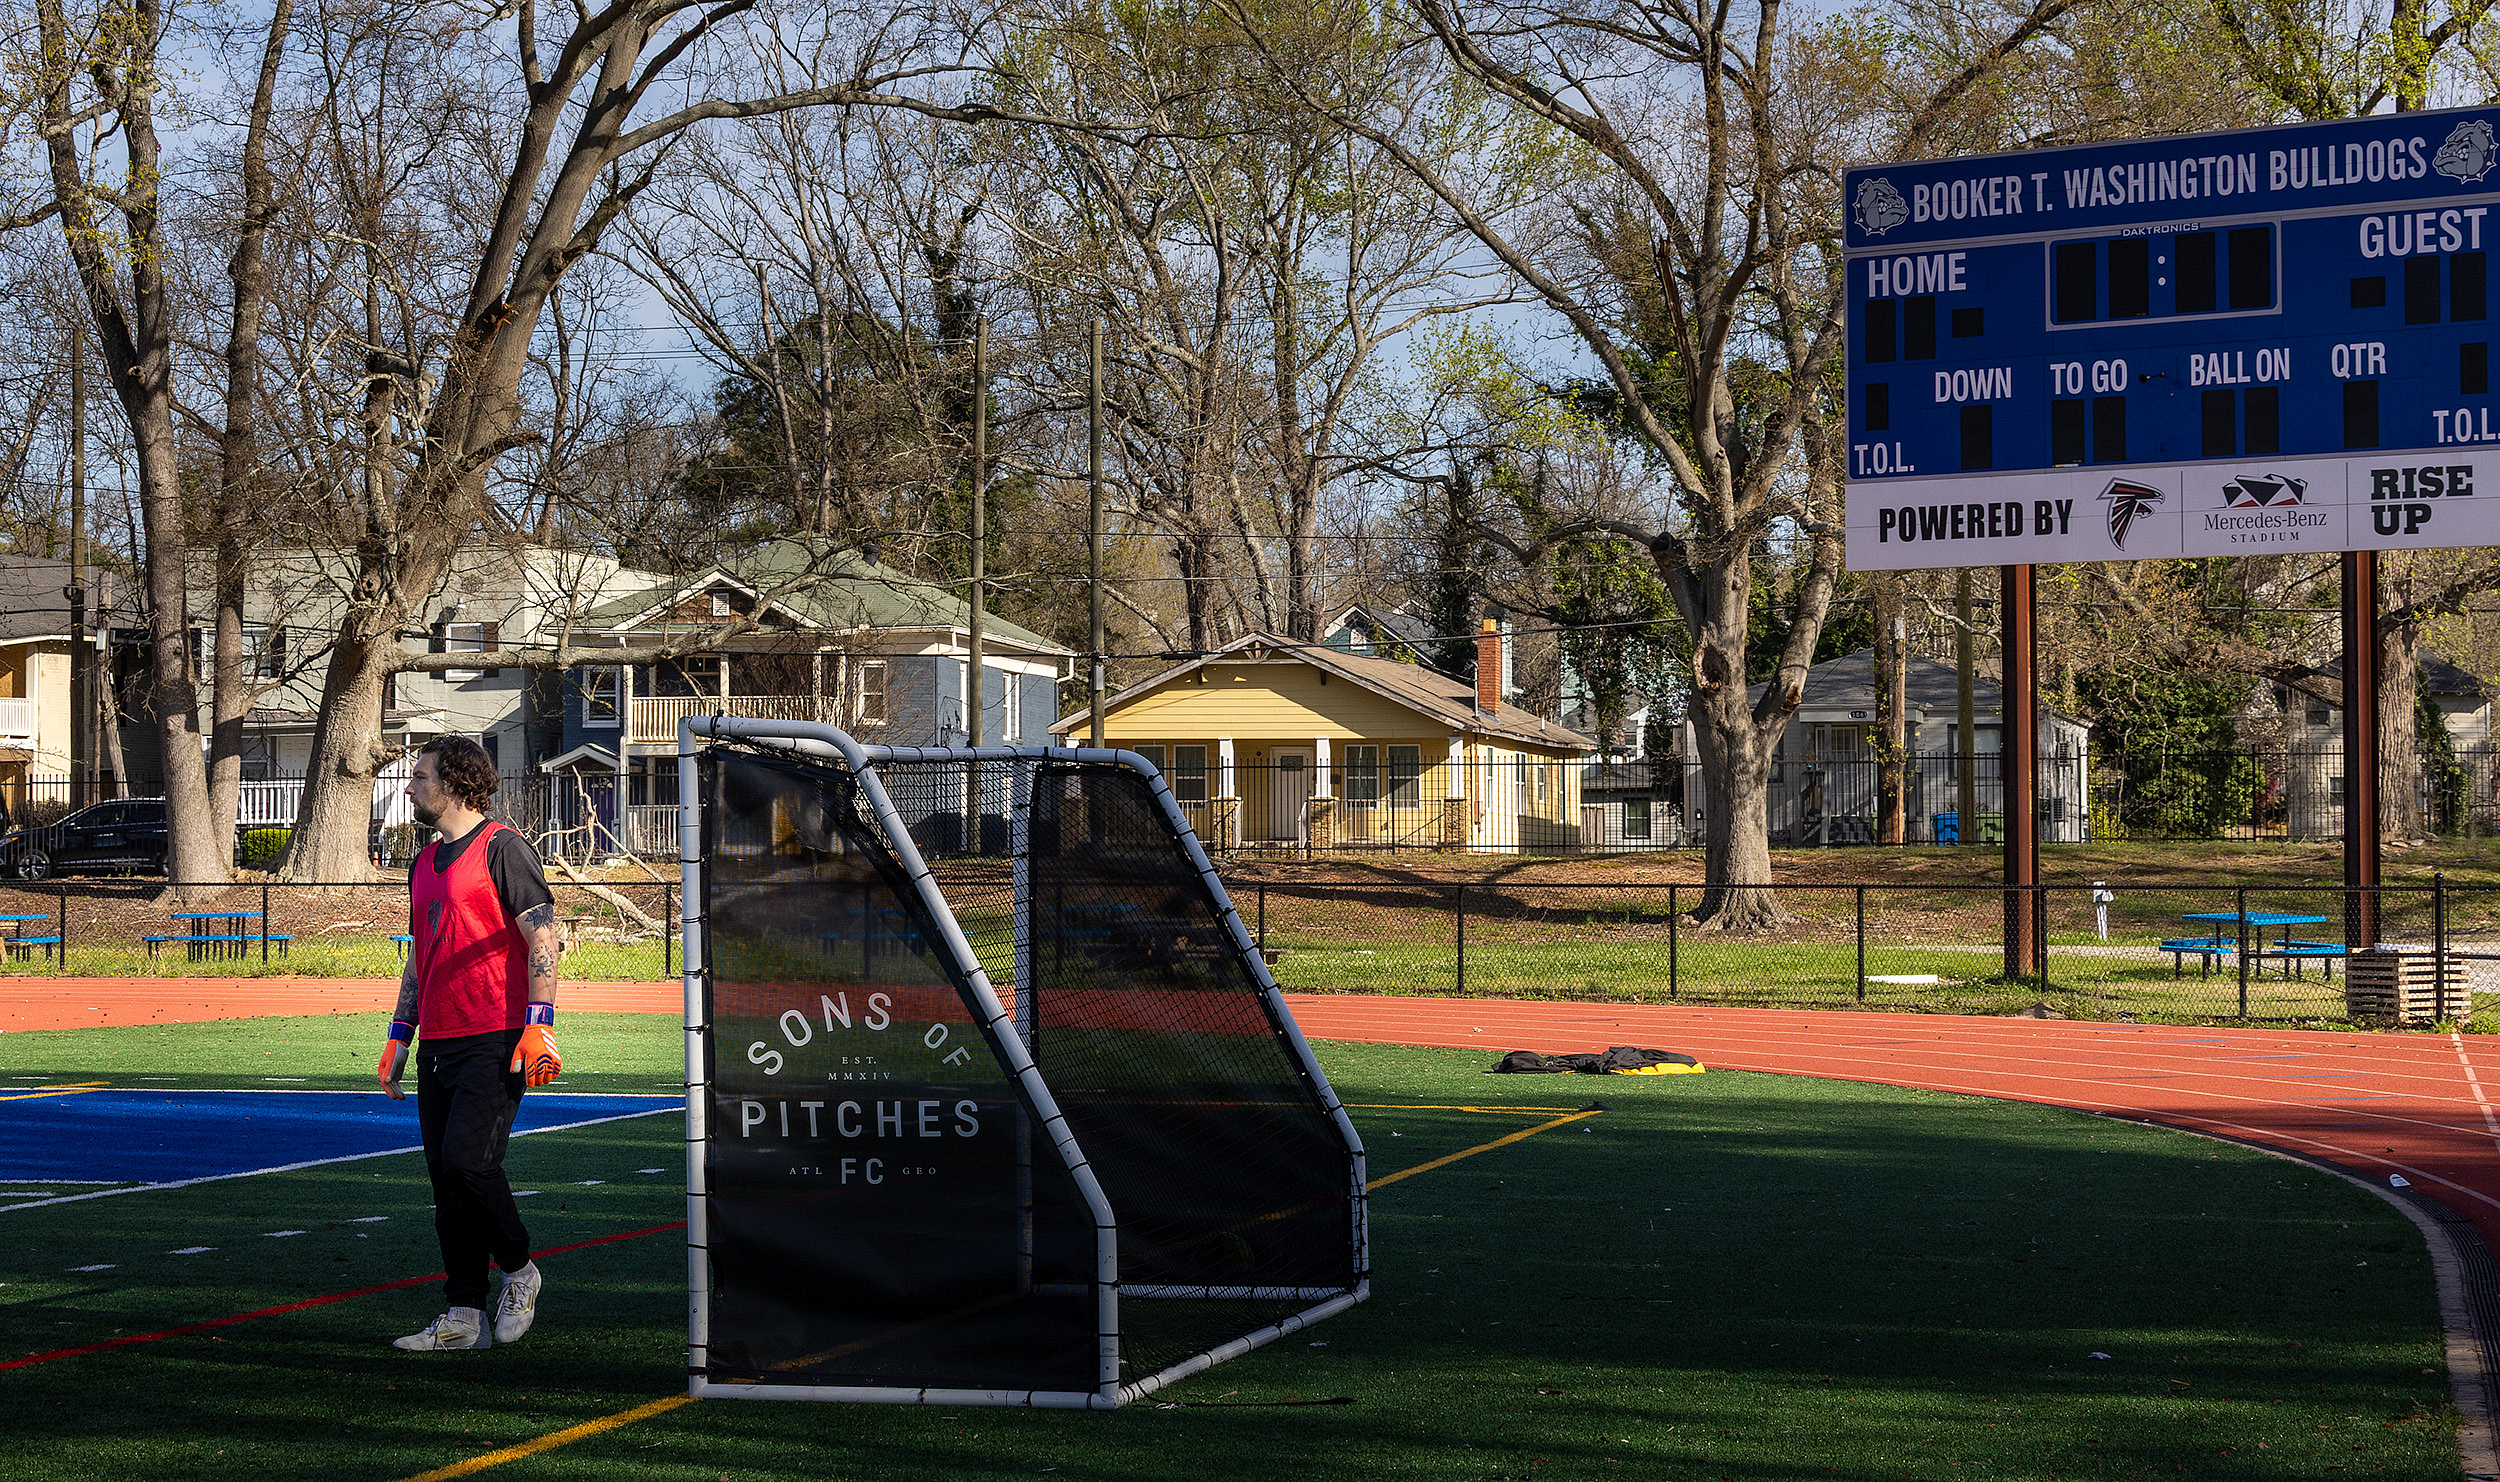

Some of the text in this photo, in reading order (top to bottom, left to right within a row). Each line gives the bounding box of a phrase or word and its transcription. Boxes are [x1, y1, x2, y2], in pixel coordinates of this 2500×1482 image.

[1913, 136, 2427, 223] BOOKER T. WASHINGTON BULLDOGS
[2122, 222, 2199, 237] DAKTRONICS
[2359, 207, 2488, 259] GUEST
[1868, 252, 1967, 298] HOME
[2049, 358, 2128, 395] TO GO
[2190, 347, 2290, 387] BALL ON
[2331, 341, 2387, 380] QTR
[1934, 366, 2012, 403] DOWN
[1854, 441, 1915, 475] T.O.L.
[2370, 464, 2474, 500] RISE
[1878, 498, 2074, 544] POWERED BY
[2203, 510, 2327, 531] Mercedes-Benz
[2230, 531, 2299, 544] STADIUM
[2370, 502, 2433, 536] UP
[747, 991, 972, 1076] SONS OF
[827, 1072, 891, 1081] MMXIV
[841, 1056, 877, 1065] EST.
[741, 1099, 979, 1138] PITCHES
[789, 1157, 937, 1185] ATL FC GEO
